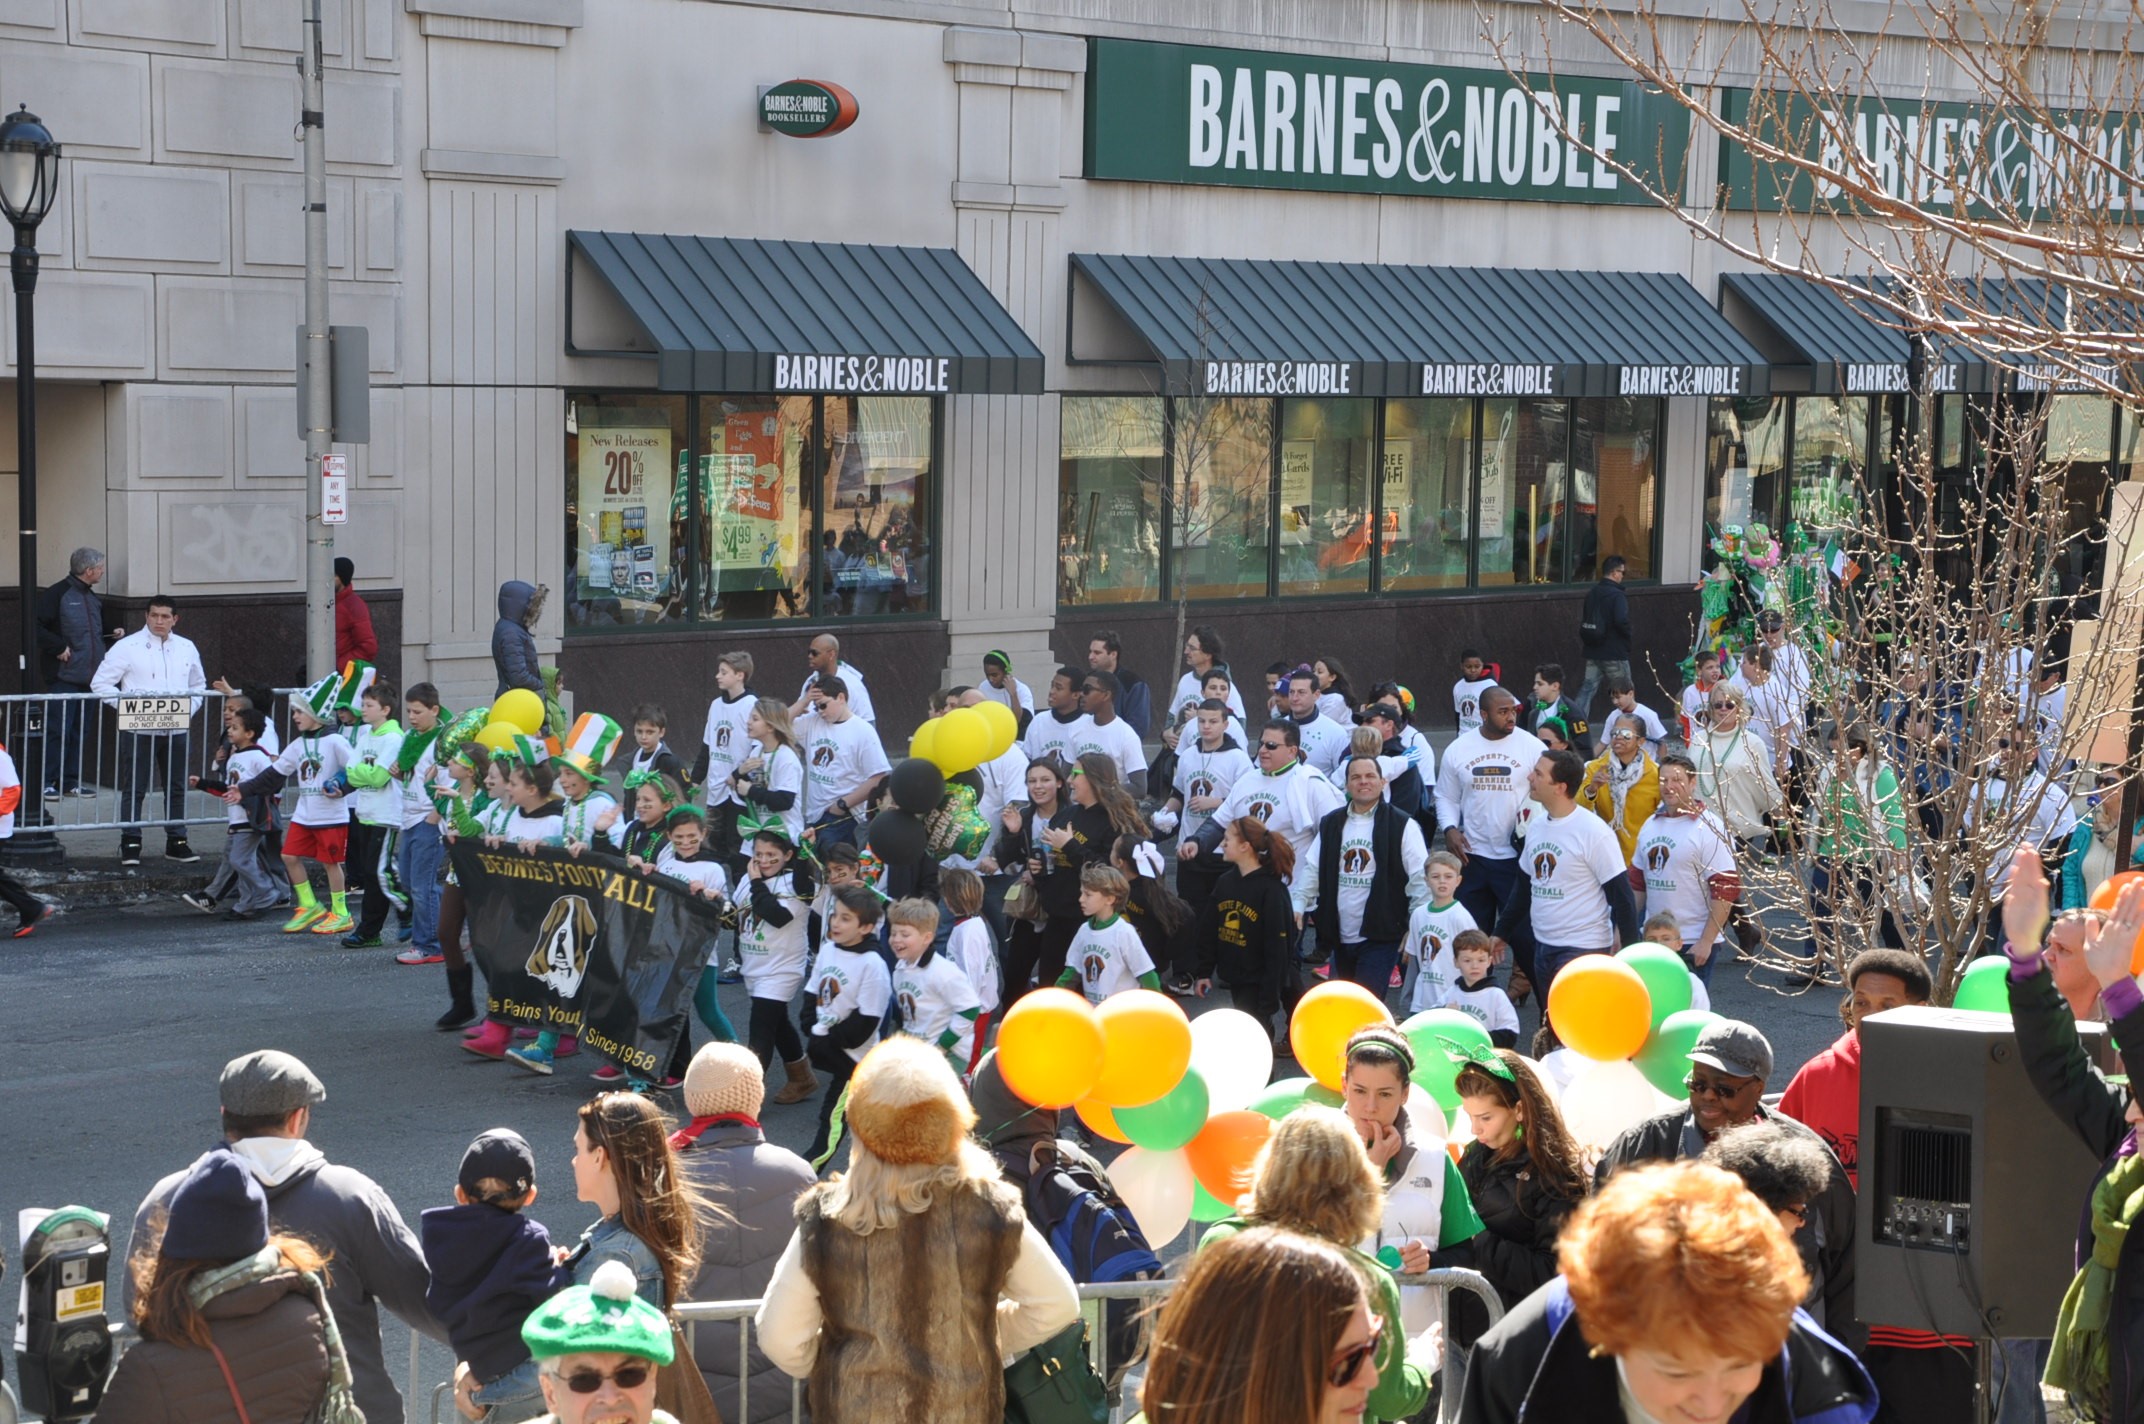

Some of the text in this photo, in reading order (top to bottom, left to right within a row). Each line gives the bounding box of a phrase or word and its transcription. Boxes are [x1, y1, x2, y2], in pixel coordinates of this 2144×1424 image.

[765, 95, 828, 112] BARNES&NOBLE
[767, 113, 826, 123] BOOKSELLERS
[1190, 64, 1621, 190] BARNES&NOBLE
[775, 355, 949, 392] BARNES&NOBLE
[1207, 361, 1350, 394] BARNES&NOBLE
[1423, 363, 1553, 395] BARNES&NOBLE
[1620, 365, 1740, 395] BARNES&NOBLE
[590, 434, 659, 447] New Releases
[1383, 453, 1403, 466] REE
[330, 481, 340, 490] ANY
[632, 474, 644, 486] OFF
[329, 495, 341, 504] TIME
[125, 700, 184, 713] W.P.P.D.
[1464, 753, 1522, 771] PROPERTY OF
[1471, 784, 1513, 792] FOOTBALL
[553, 862, 657, 913] FOOTALL
[1460, 1004, 1488, 1021] RNIES
[585, 1028, 618, 1055] Since
[617, 1044, 656, 1071] 1958
